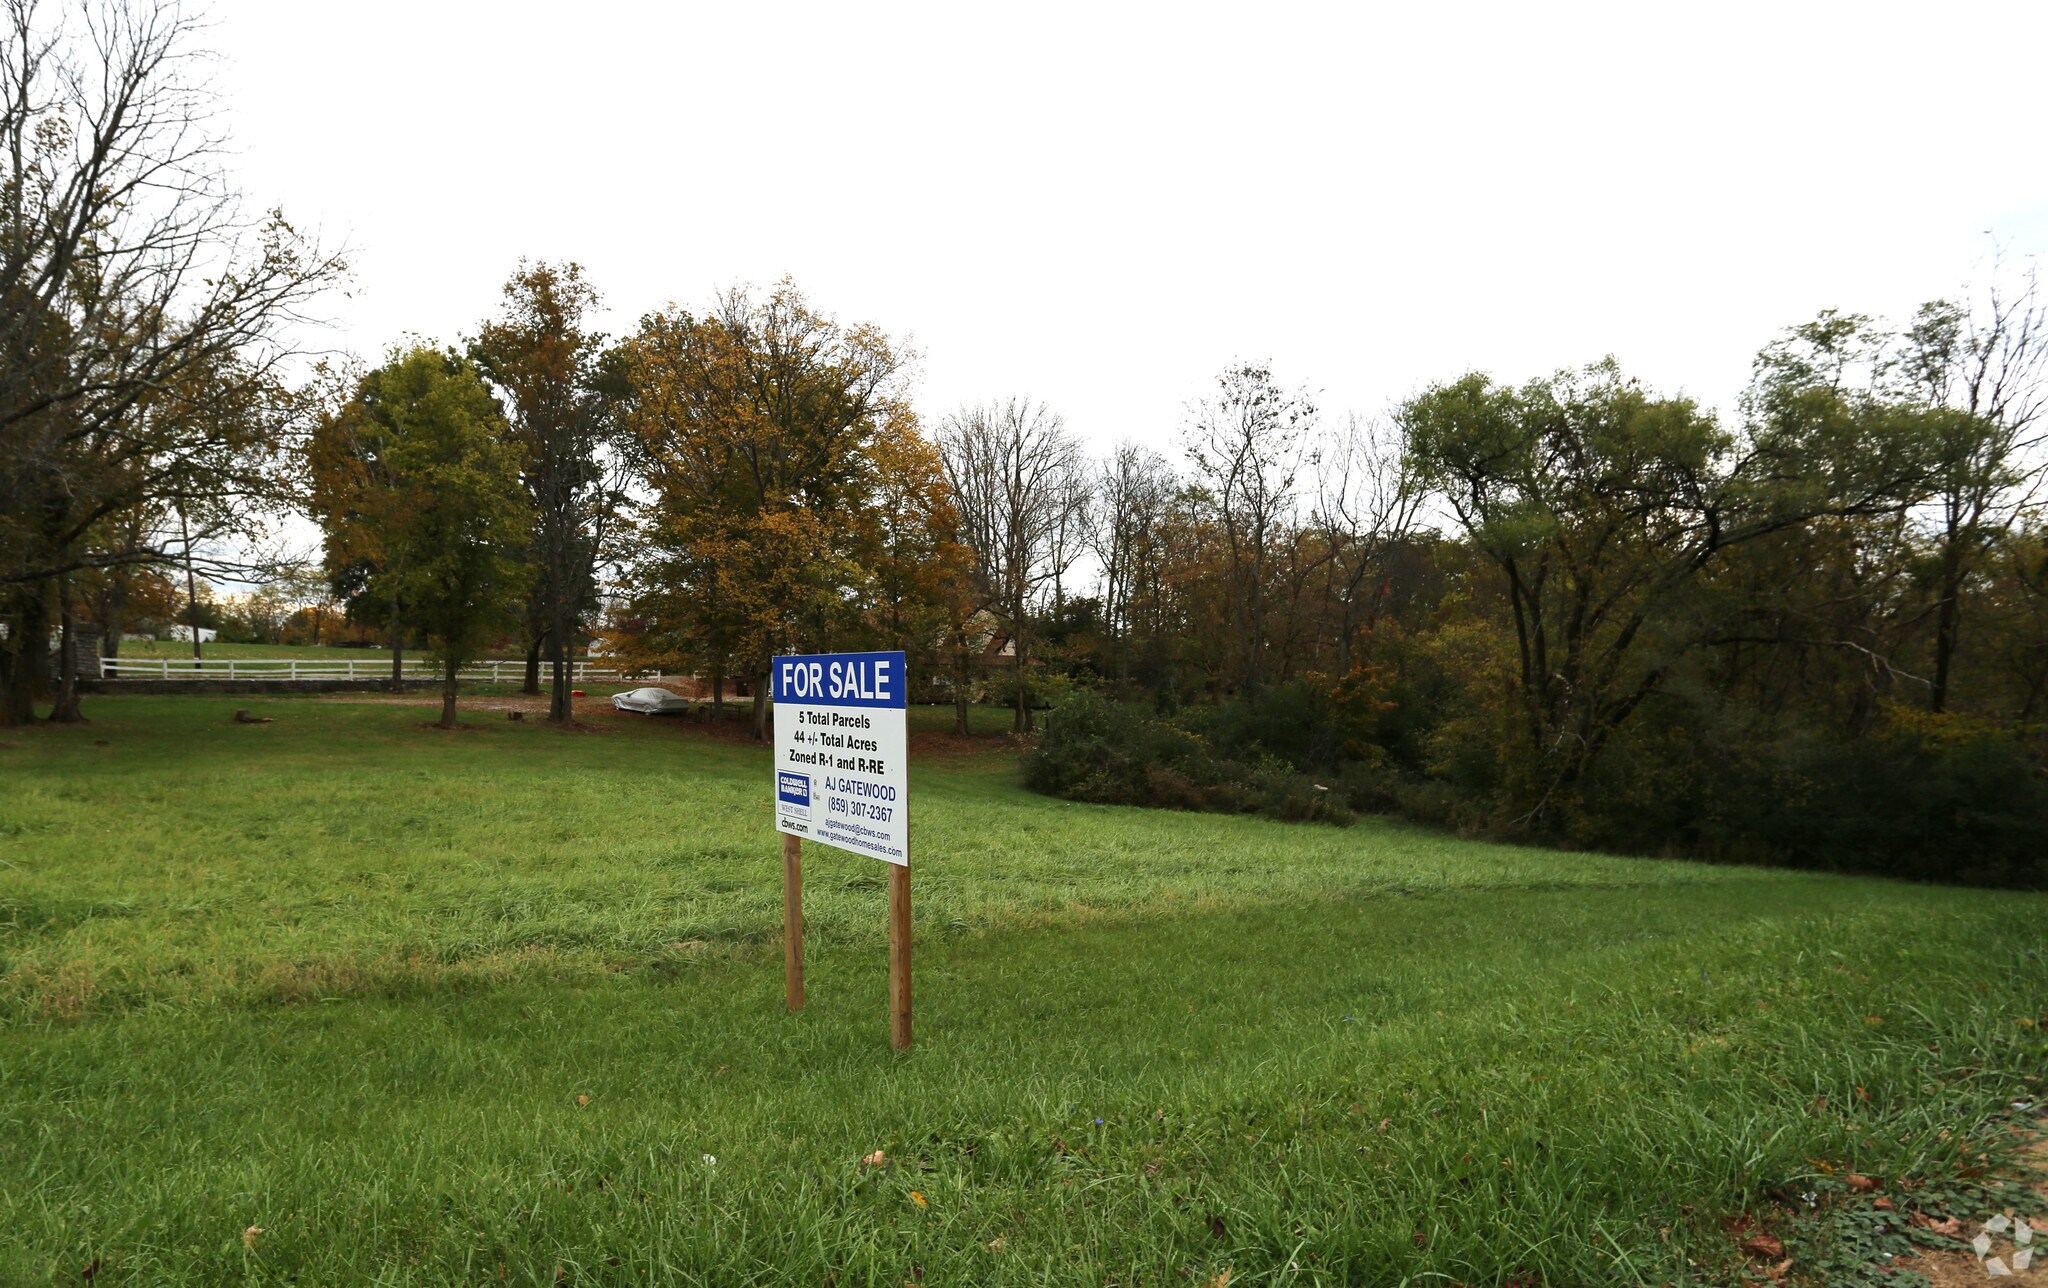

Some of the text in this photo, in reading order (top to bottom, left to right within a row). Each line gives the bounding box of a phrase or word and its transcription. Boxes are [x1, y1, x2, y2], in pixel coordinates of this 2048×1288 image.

[782, 660, 891, 700] FOR SALE
[799, 711, 871, 729] 5 Total Parcels
[794, 730, 878, 752] 44 +/- Total Acres
[789, 749, 885, 775] Zoned R-1 and R-RE
[825, 776, 838, 792] AJ
[838, 778, 896, 802] GATEWOOD
[828, 796, 893, 823] (859) 307-2367
[781, 817, 809, 833] cbws.com
[825, 817, 891, 841] ajgatewood@cbws.com
[816, 828, 902, 858] www.gatewoodhomesales.com
